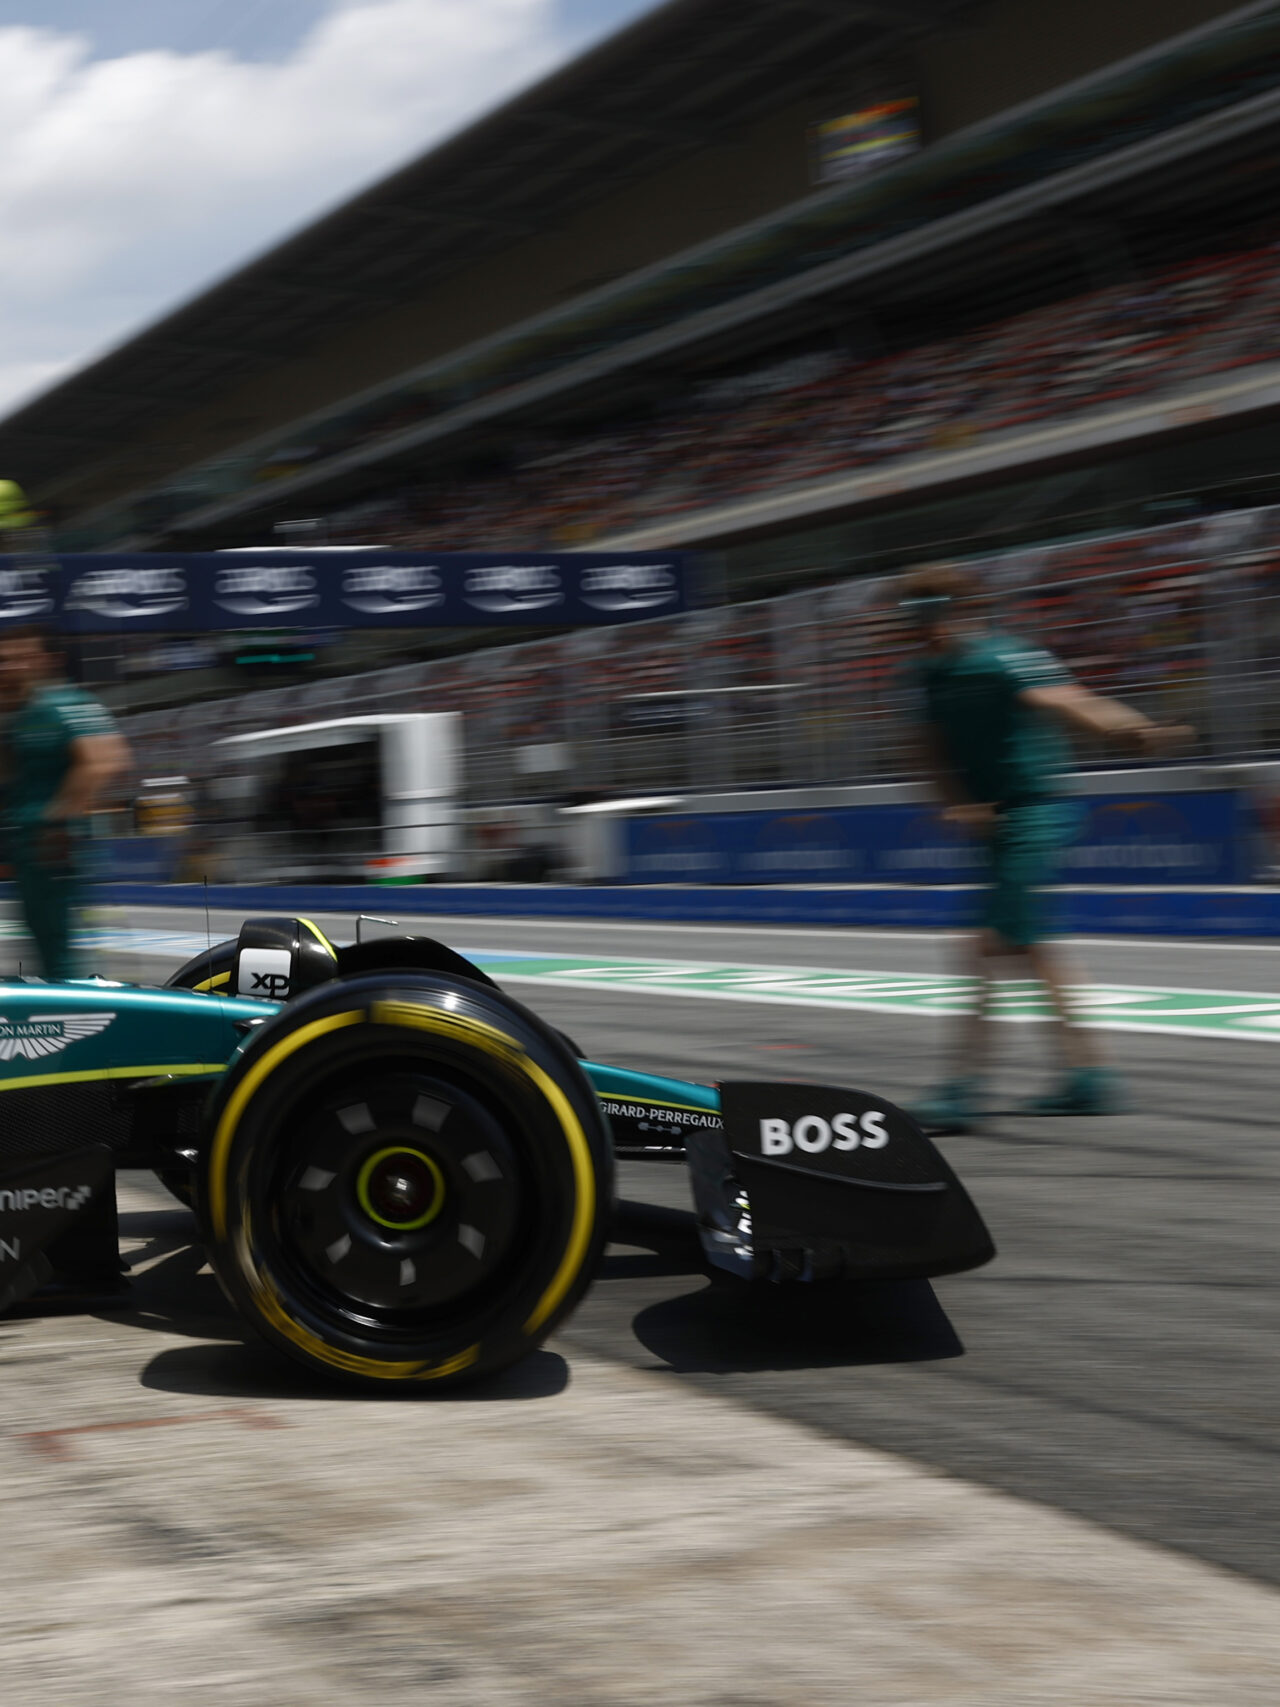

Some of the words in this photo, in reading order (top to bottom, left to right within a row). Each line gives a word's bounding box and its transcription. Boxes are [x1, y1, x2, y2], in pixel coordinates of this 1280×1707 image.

[16, 1023, 62, 1036] MARTIN
[599, 1101, 724, 1130] GIRARD-PERREGAUX
[759, 1110, 890, 1156] BOSS
